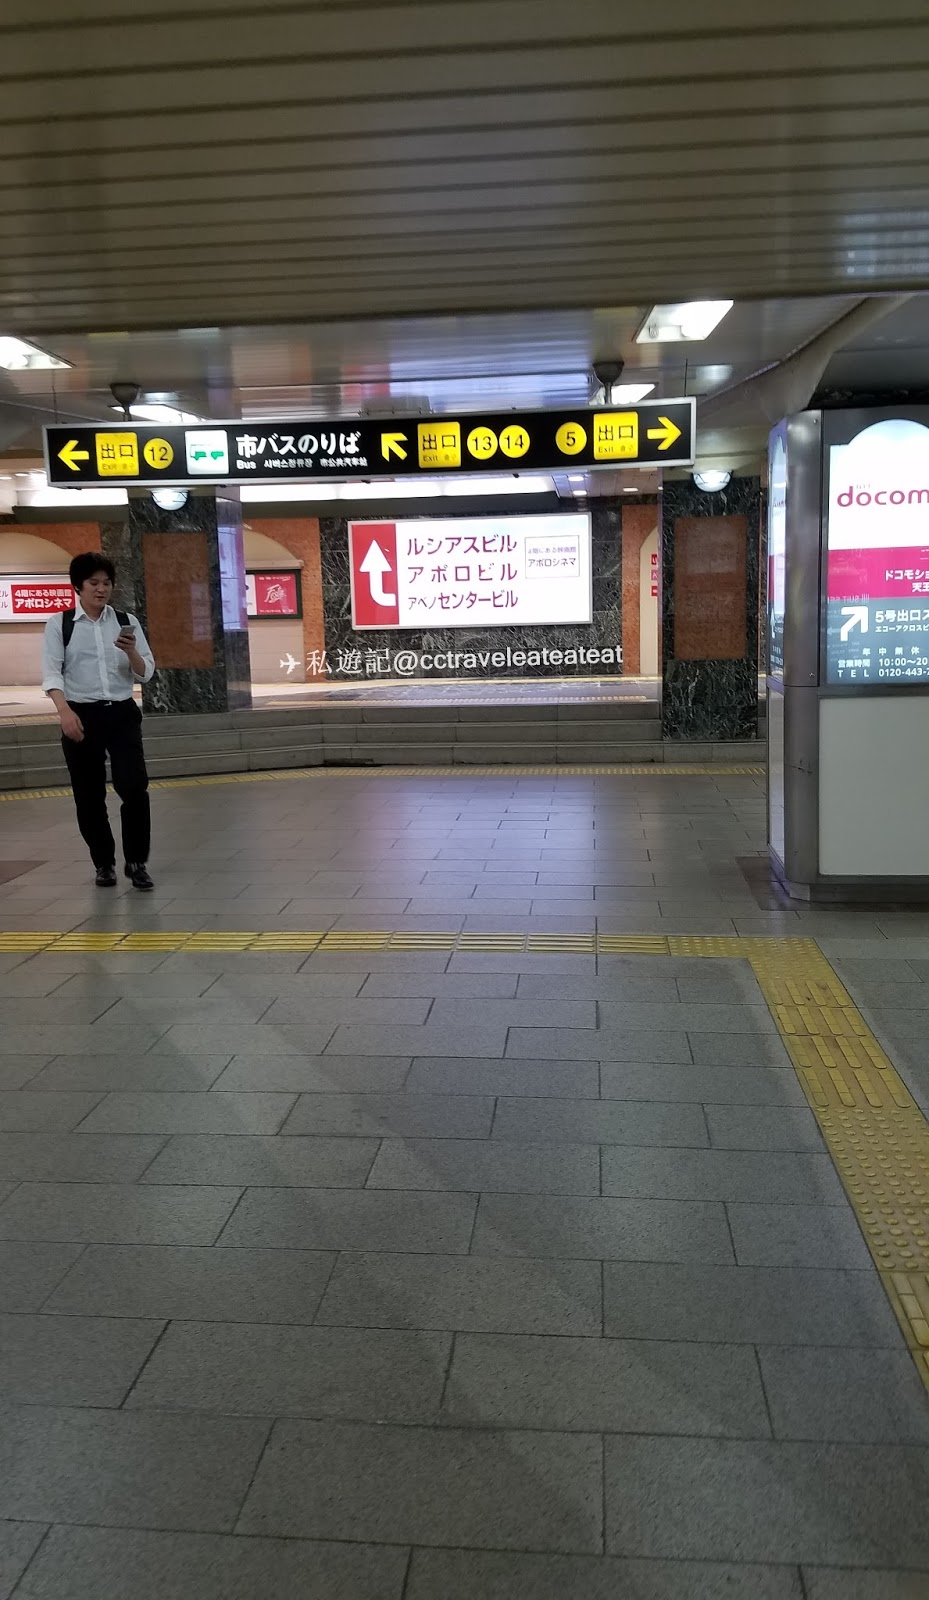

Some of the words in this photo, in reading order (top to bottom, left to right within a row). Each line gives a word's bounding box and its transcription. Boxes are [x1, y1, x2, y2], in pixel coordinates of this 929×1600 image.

[565, 431, 576, 447] 5
[598, 424, 634, 442] 出口
[235, 430, 361, 458] 市バスのりば
[422, 433, 456, 451] 出口
[473, 435, 492, 451] 13
[504, 434, 524, 450] 14
[101, 443, 133, 460] 出口
[149, 446, 168, 461] 12
[236, 459, 256, 469] Bus
[406, 534, 517, 556] ルシアスビル
[528, 557, 576, 568] アポロシネマ
[408, 562, 518, 584] アポロビル
[15, 597, 72, 608] アポロシネマ
[408, 589, 518, 610] アベノセンタービル
[838, 659, 870, 668] 営業時間
